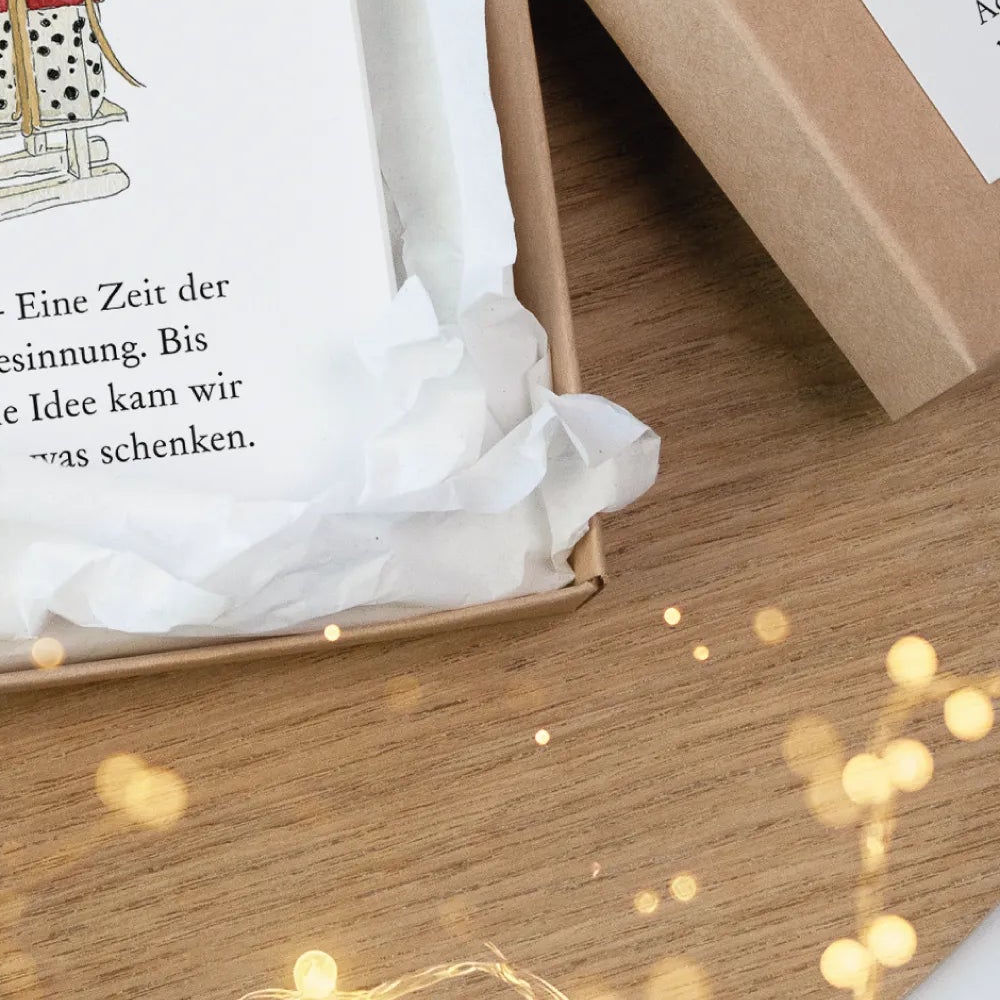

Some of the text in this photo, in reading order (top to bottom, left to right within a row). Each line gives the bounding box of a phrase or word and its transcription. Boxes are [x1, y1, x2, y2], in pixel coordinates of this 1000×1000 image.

[15, 289, 89, 321] Eine
[98, 278, 167, 312] Zeit
[177, 271, 230, 303] der
[157, 324, 208, 356] Bis
[28, 389, 97, 422] Idee
[107, 382, 178, 413] kam
[187, 371, 243, 403] wir
[100, 426, 255, 465] schenken.
